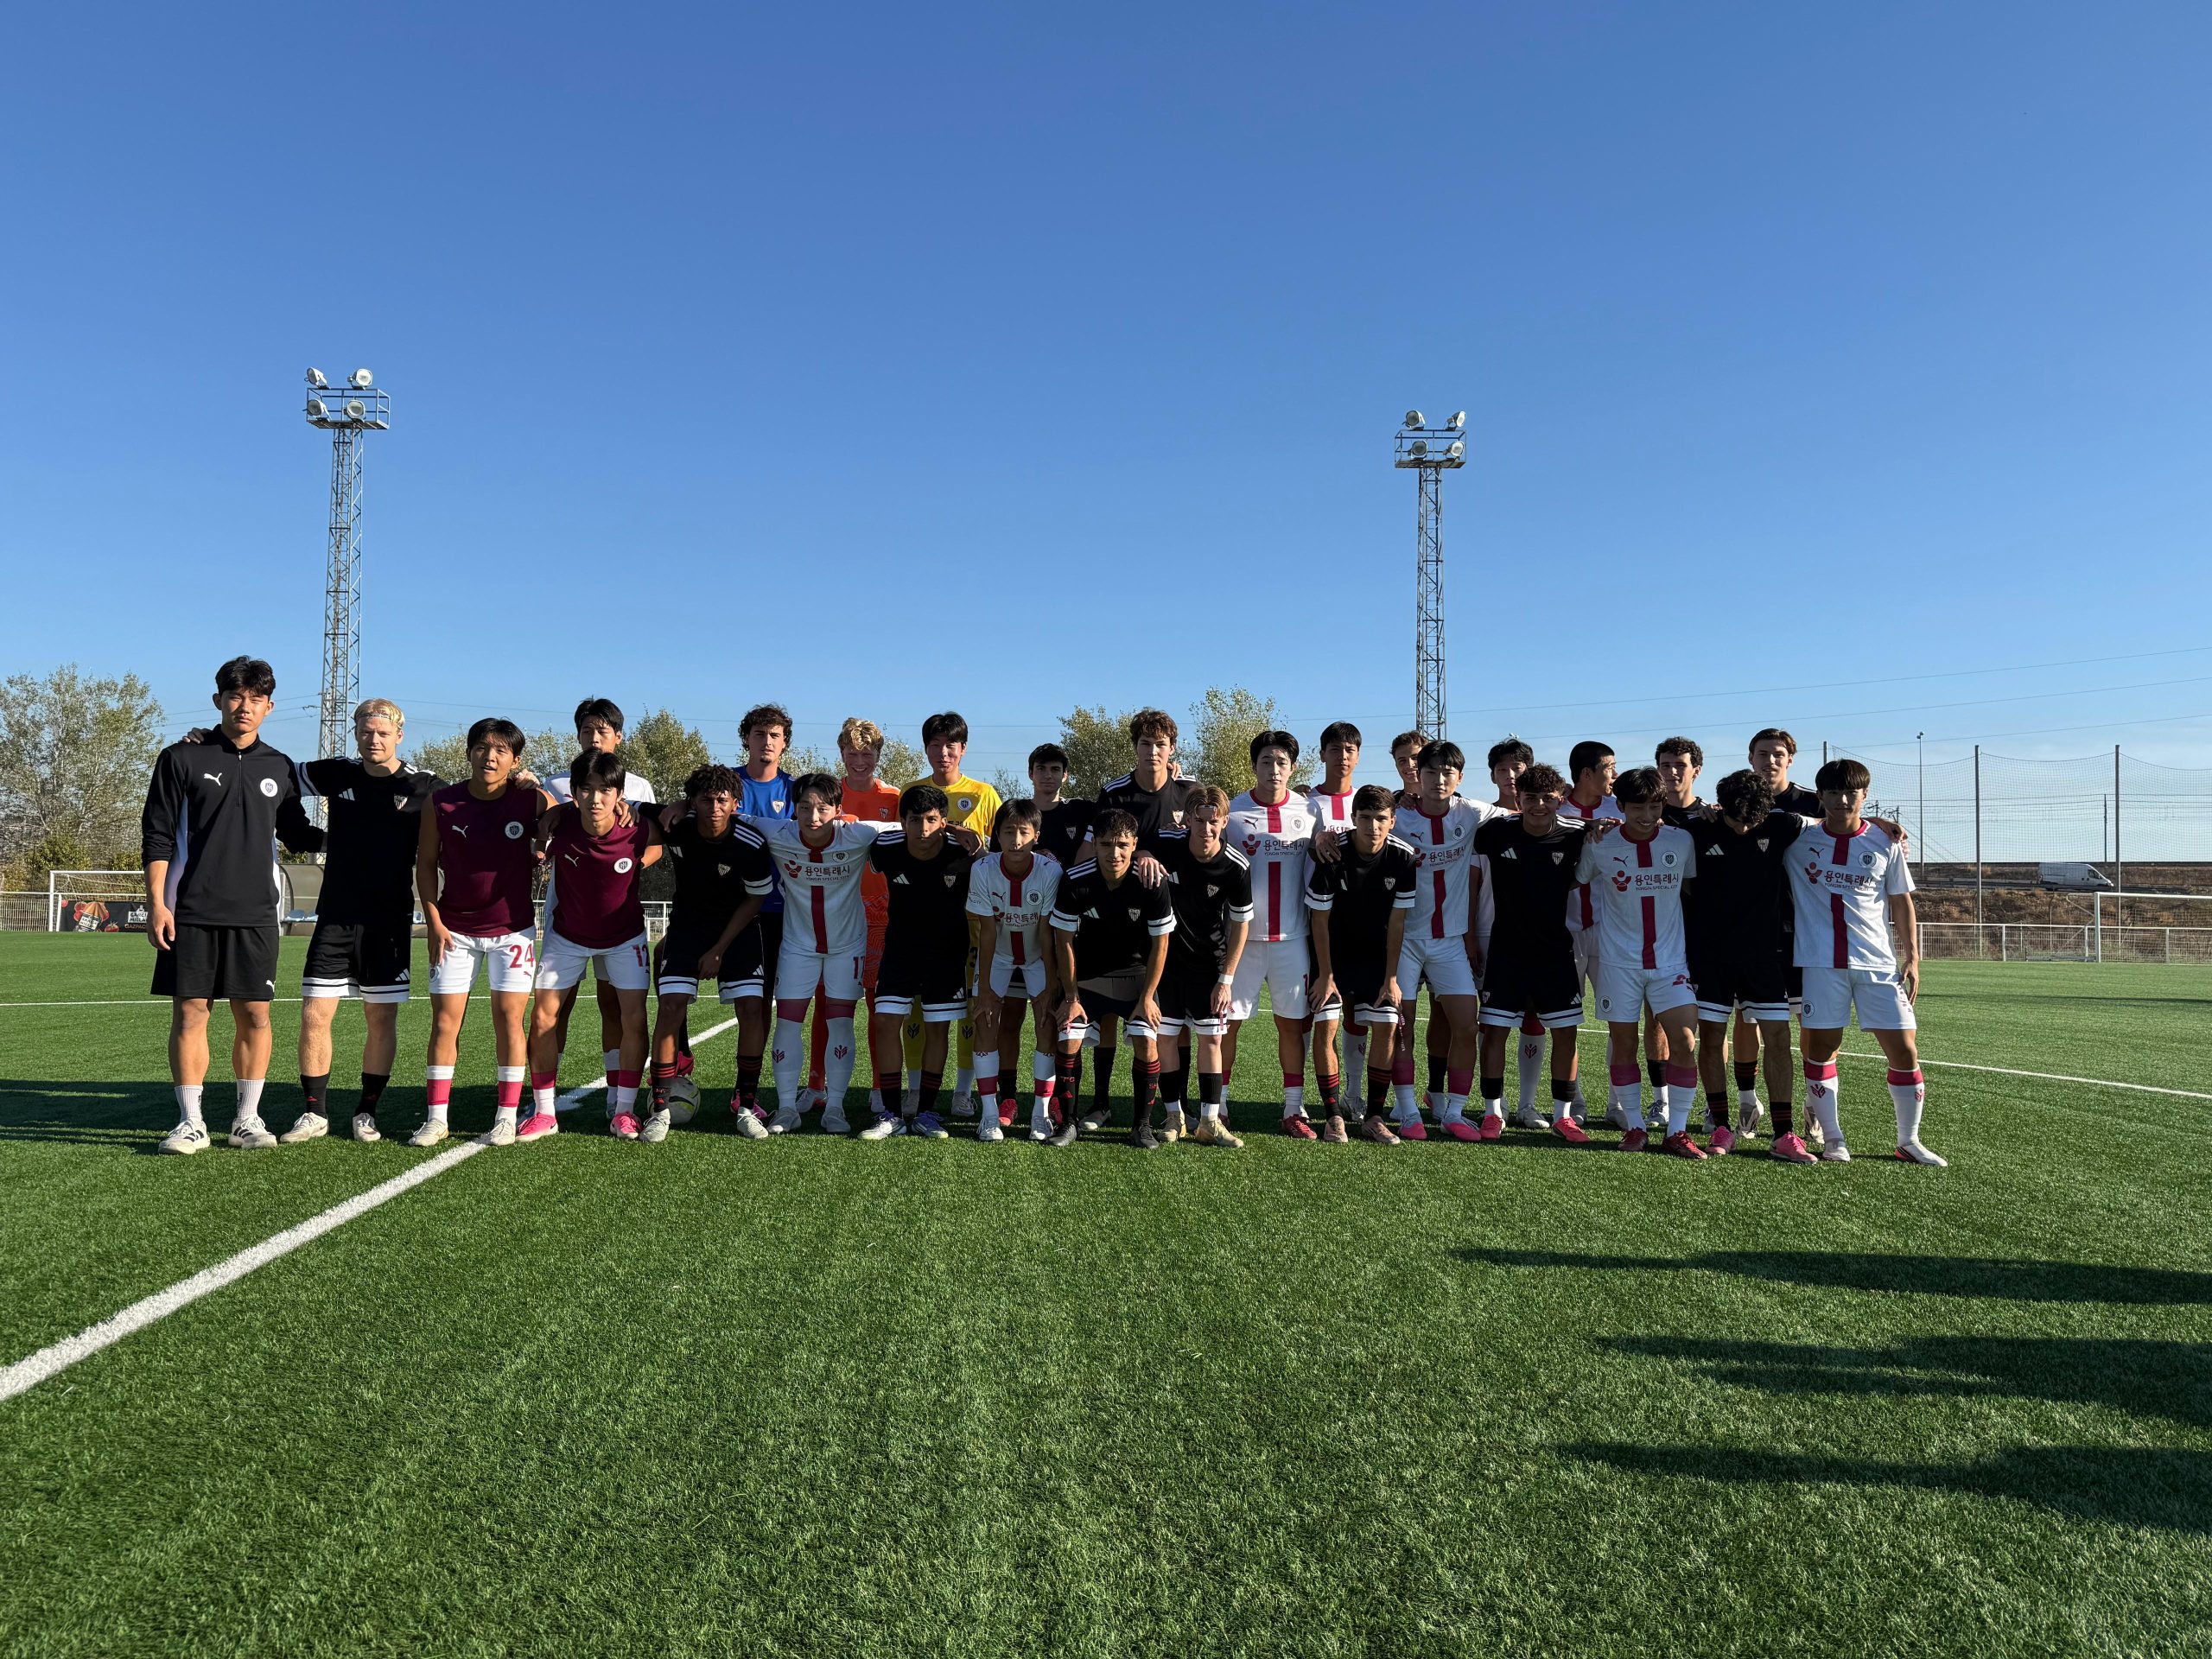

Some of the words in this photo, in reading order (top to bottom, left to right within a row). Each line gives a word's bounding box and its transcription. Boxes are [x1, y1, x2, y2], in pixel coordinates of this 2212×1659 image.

[1263, 839, 1306, 851] 용인특레시
[804, 865, 850, 877] 용인특레시
[1634, 873, 1679, 886] 용인특레시
[1824, 870, 1873, 886] 용인특레시
[510, 943, 534, 969] 24
